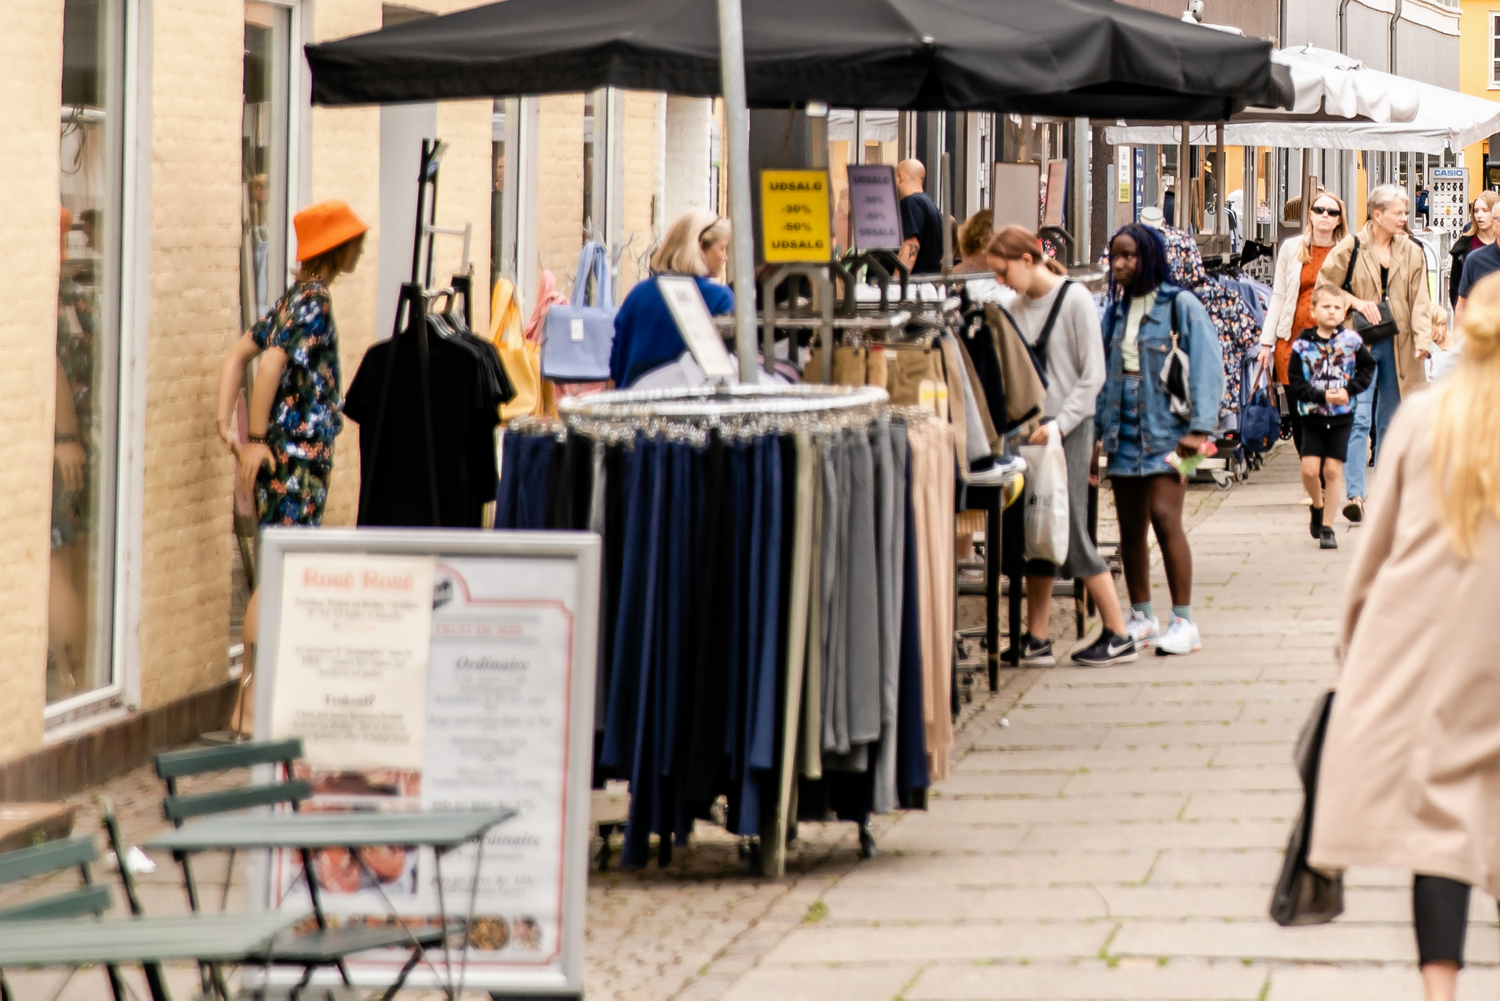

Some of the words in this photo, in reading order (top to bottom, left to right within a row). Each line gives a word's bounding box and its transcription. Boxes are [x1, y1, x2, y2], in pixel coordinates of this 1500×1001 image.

[1434, 169, 1463, 177] CASIO
[853, 175, 889, 185] UDSALG
[769, 181, 822, 191] UDSALG
[859, 227, 896, 236] UDSALG
[771, 239, 824, 249] UDSALG
[302, 568, 354, 588] Rosé
[361, 569, 414, 591] Rosé
[456, 655, 529, 671] Ordinaire
